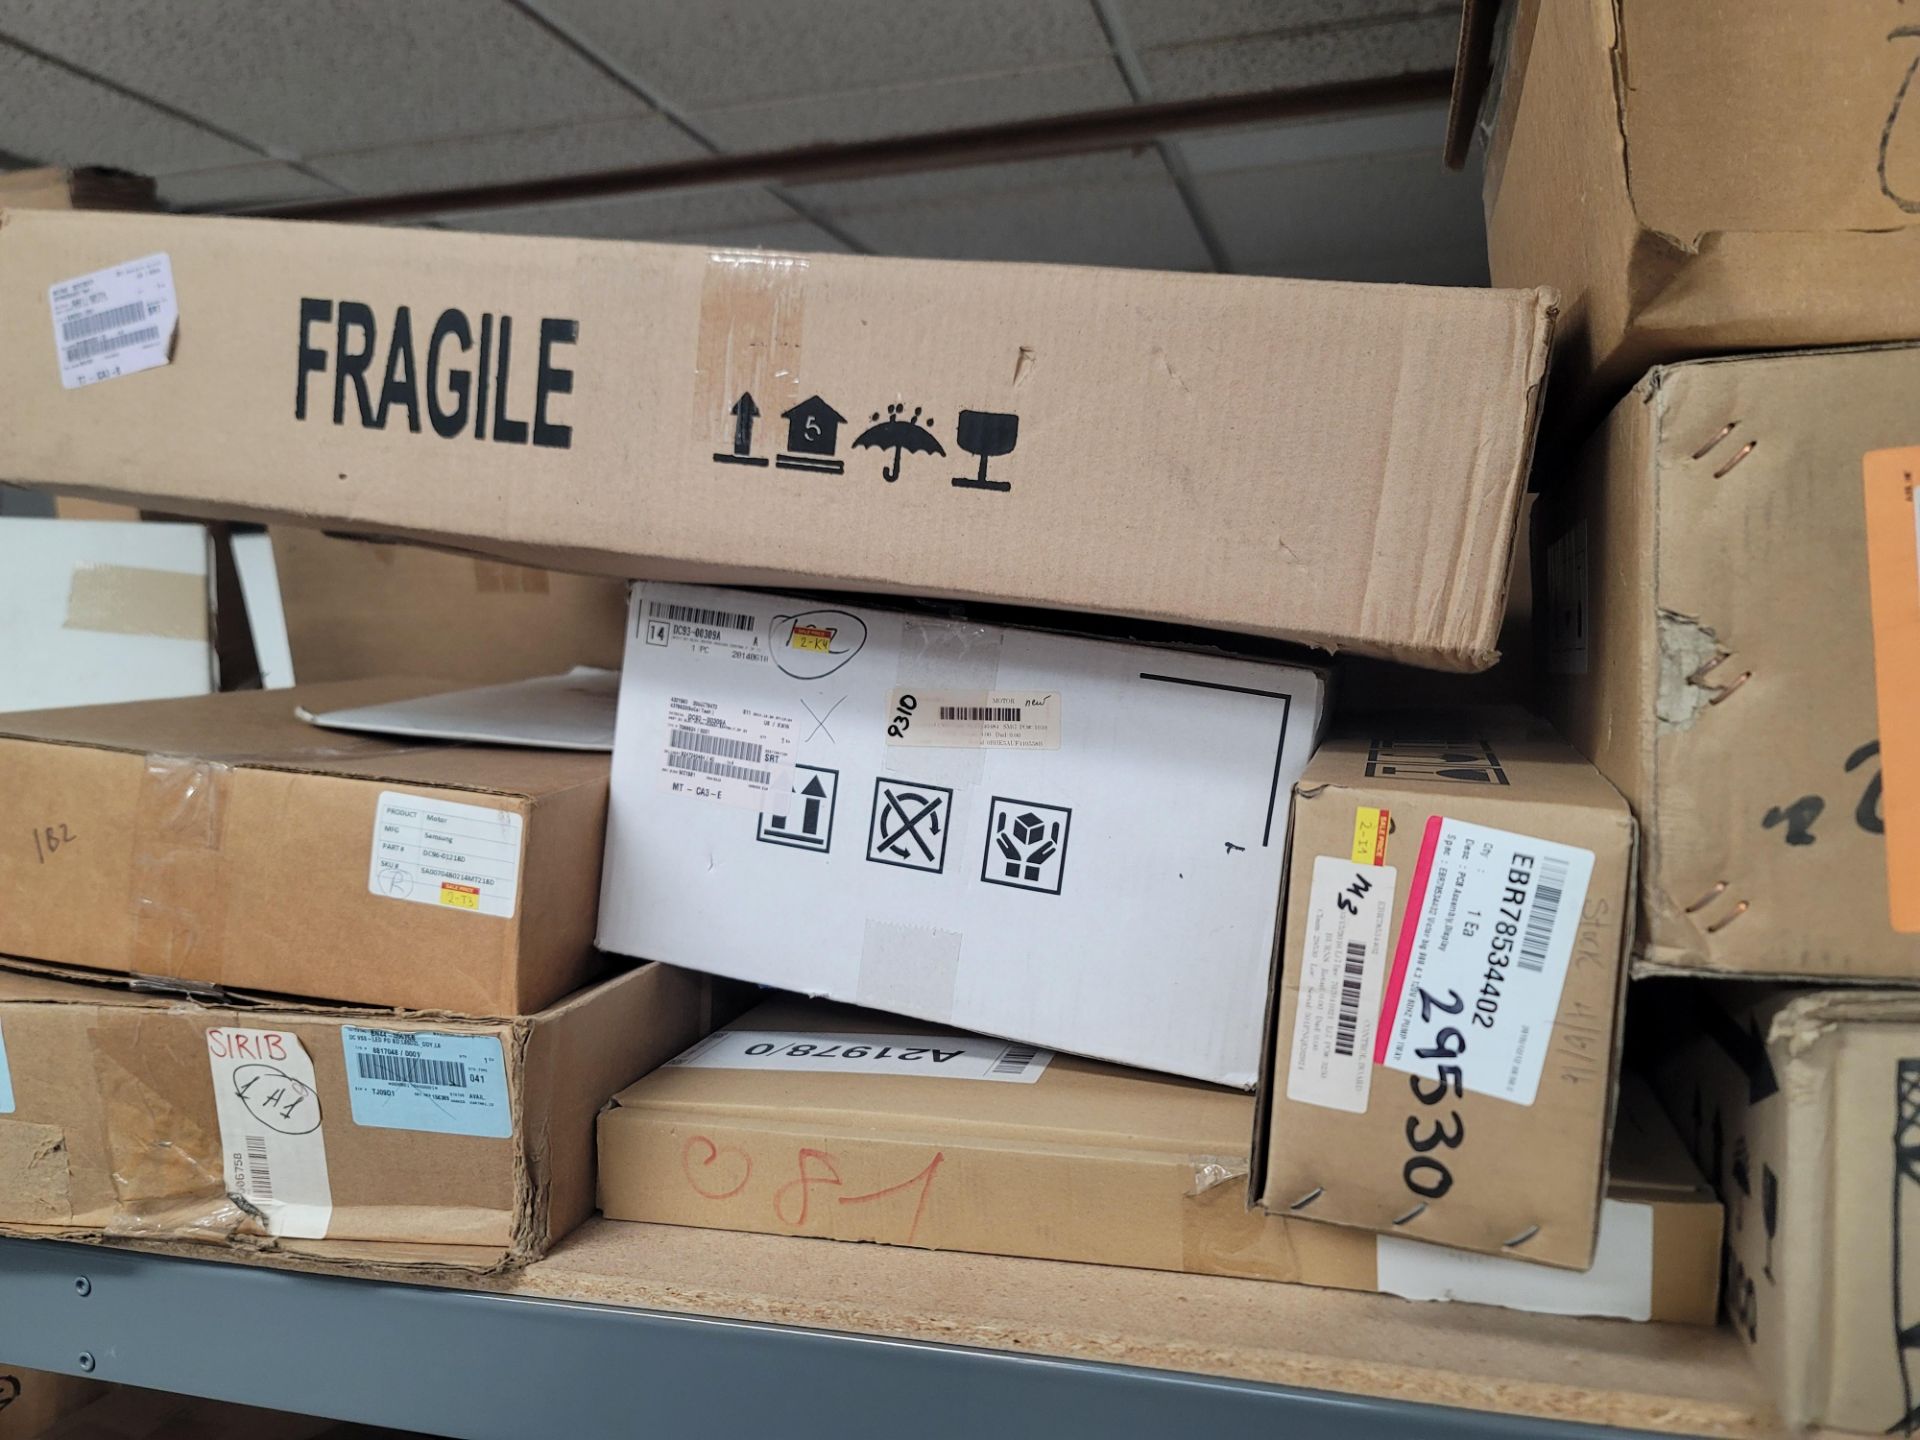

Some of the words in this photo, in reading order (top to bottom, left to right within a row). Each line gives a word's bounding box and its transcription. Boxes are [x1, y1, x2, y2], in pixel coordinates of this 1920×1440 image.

[295, 297, 578, 449] FRAGILE
[651, 626, 665, 642] 14
[887, 694, 918, 738] 9310
[386, 808, 418, 818] PRODUCT
[426, 814, 448, 824] Motor
[384, 825, 400, 834] MFG
[424, 832, 454, 844] Samsung
[382, 843, 400, 852] PART
[380, 861, 394, 869] SKU
[1461, 919, 1480, 938] Ea
[1470, 850, 1536, 1030] EBR78534402
[744, 1043, 966, 1063] A21978/0
[469, 1073, 485, 1084] 041
[1403, 986, 1466, 1198] 29530
